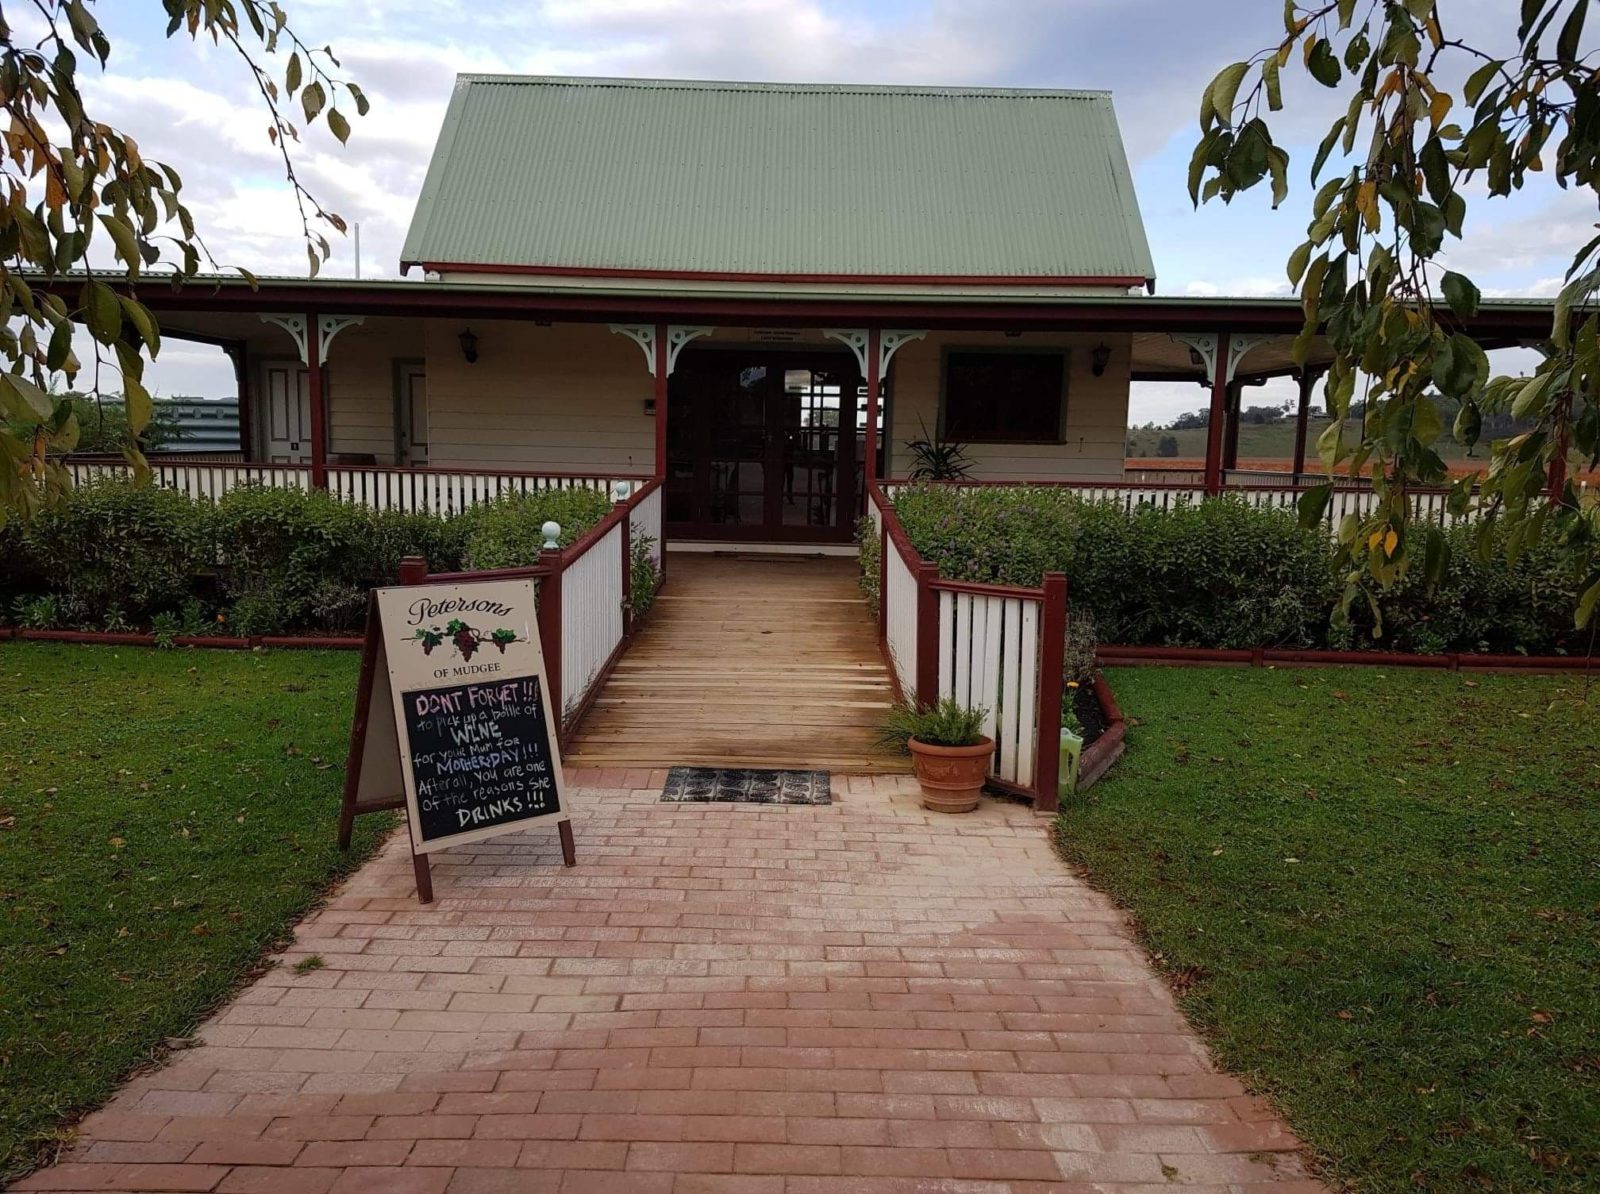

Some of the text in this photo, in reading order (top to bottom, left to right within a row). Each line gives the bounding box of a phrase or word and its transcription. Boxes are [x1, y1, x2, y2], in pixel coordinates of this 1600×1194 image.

[407, 597, 514, 625] Petersons
[434, 662, 501, 678] OF MUDGEE
[416, 691, 462, 716] DONT
[468, 683, 518, 708] FORGET
[416, 704, 537, 737] to pick up a bottle of
[450, 721, 502, 746] WINE
[414, 752, 435, 768] for
[504, 767, 524, 778] are
[526, 760, 546, 772] one
[446, 793, 468, 806] the
[473, 781, 524, 800] reasons
[456, 797, 522, 827] DRINKS
